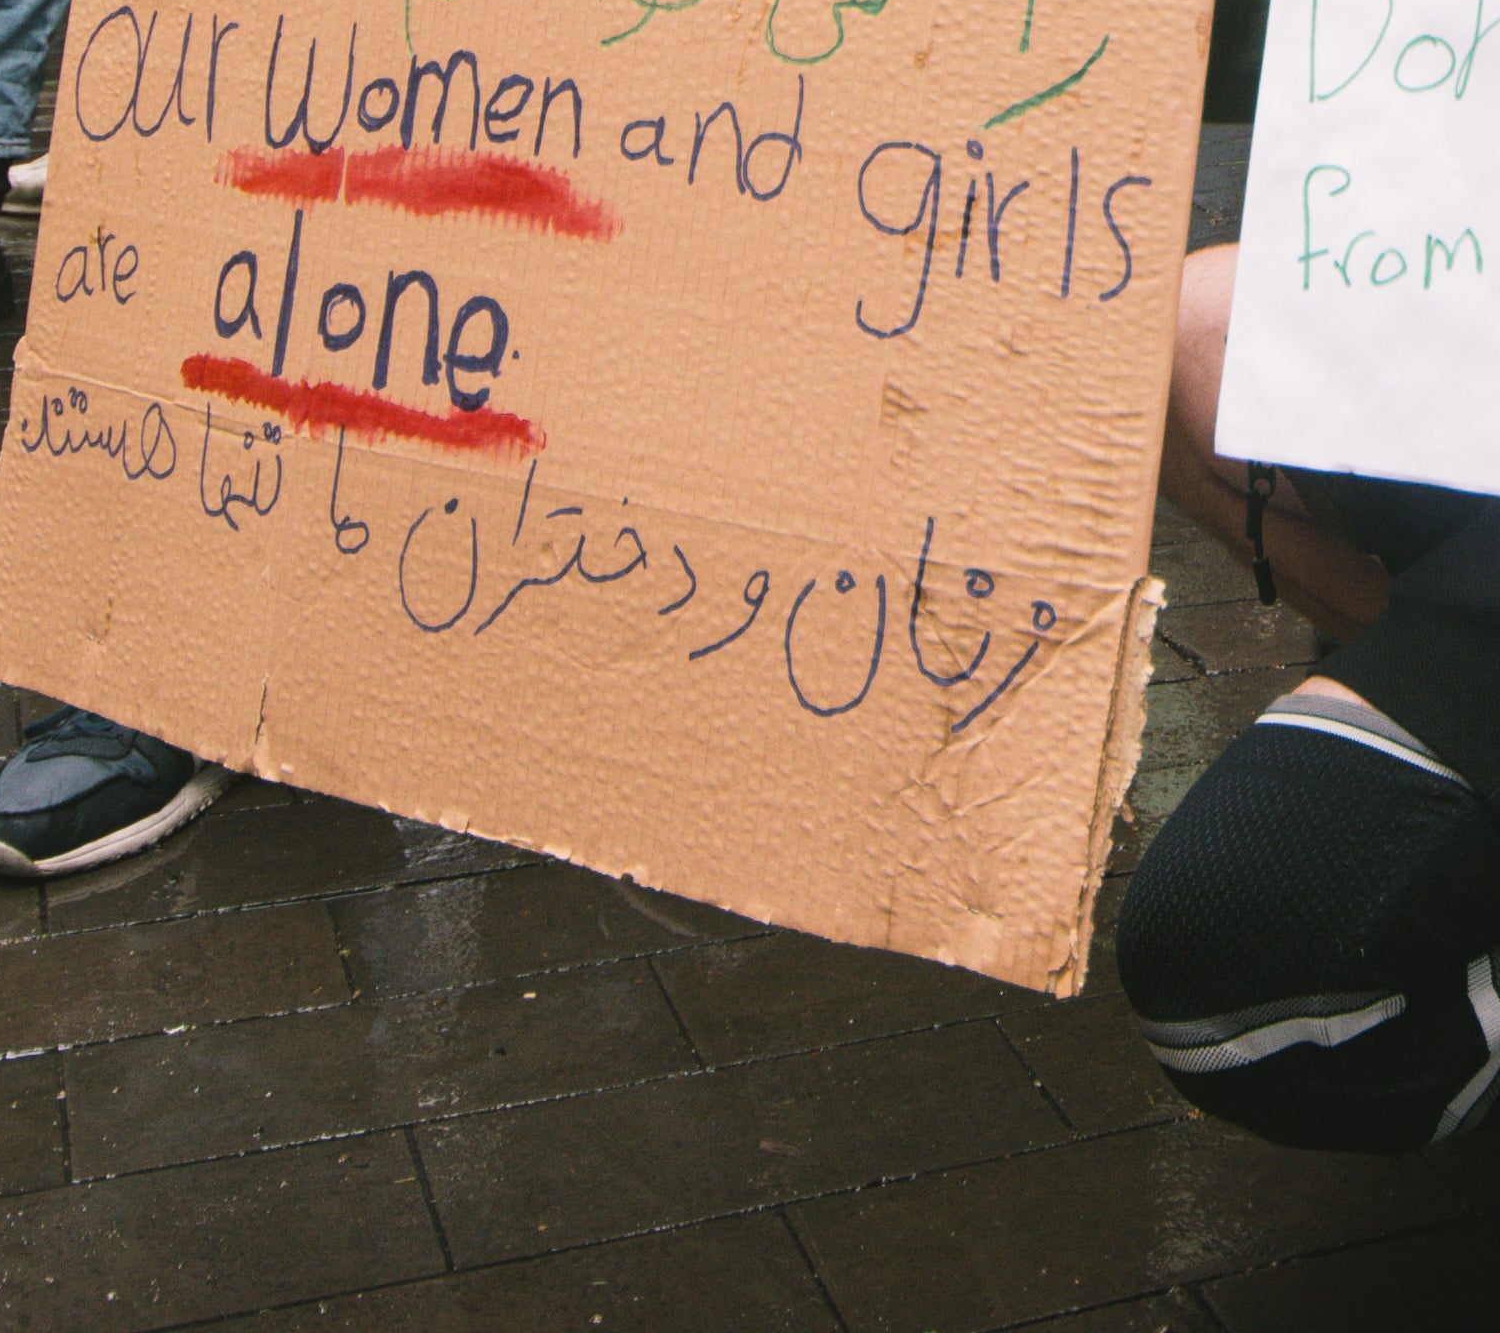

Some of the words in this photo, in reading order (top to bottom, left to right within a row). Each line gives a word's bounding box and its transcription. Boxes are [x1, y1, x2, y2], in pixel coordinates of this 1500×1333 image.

[620, 73, 806, 203] and
[856, 138, 1153, 340] girls
[1297, 164, 1485, 293] from
[330, 424, 371, 555] ما
